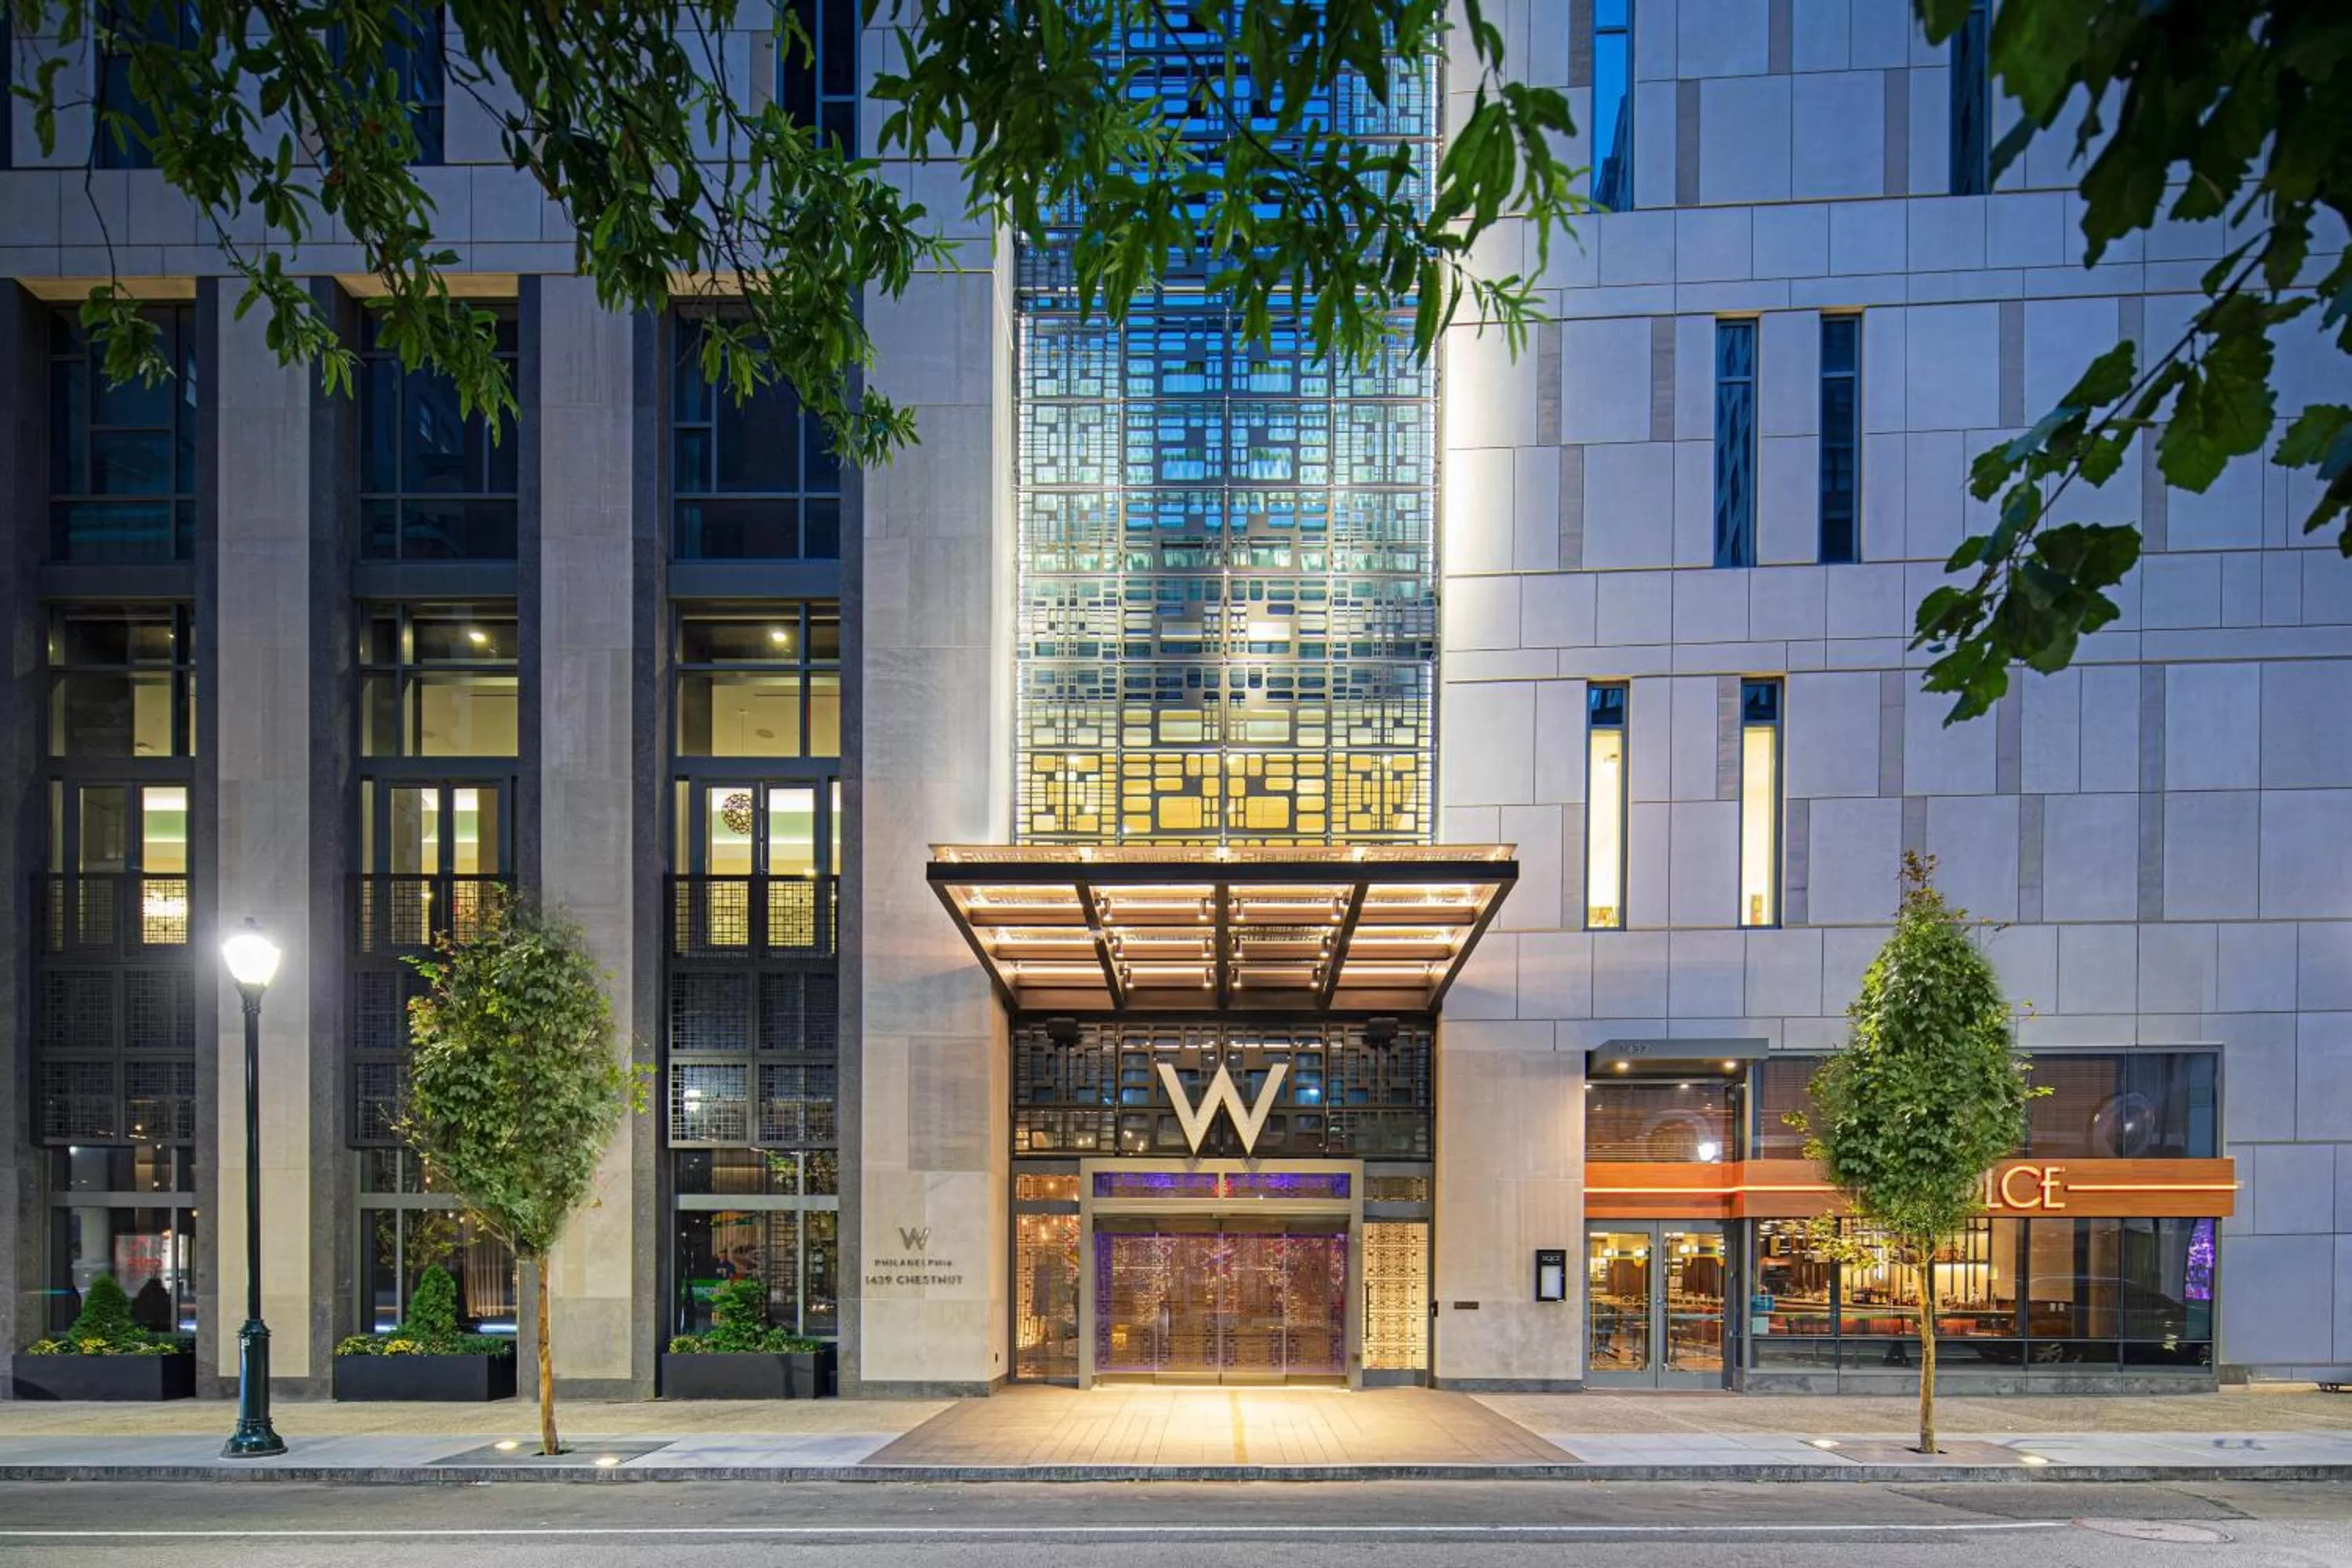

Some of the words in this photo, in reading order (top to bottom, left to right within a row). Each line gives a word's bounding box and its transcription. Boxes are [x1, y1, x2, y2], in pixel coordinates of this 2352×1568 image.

[1156, 1062, 1289, 1156] W
[1984, 1166, 2066, 1209] LCE
[898, 1227, 931, 1250] W
[895, 1276, 963, 1285] CHESTNUT
